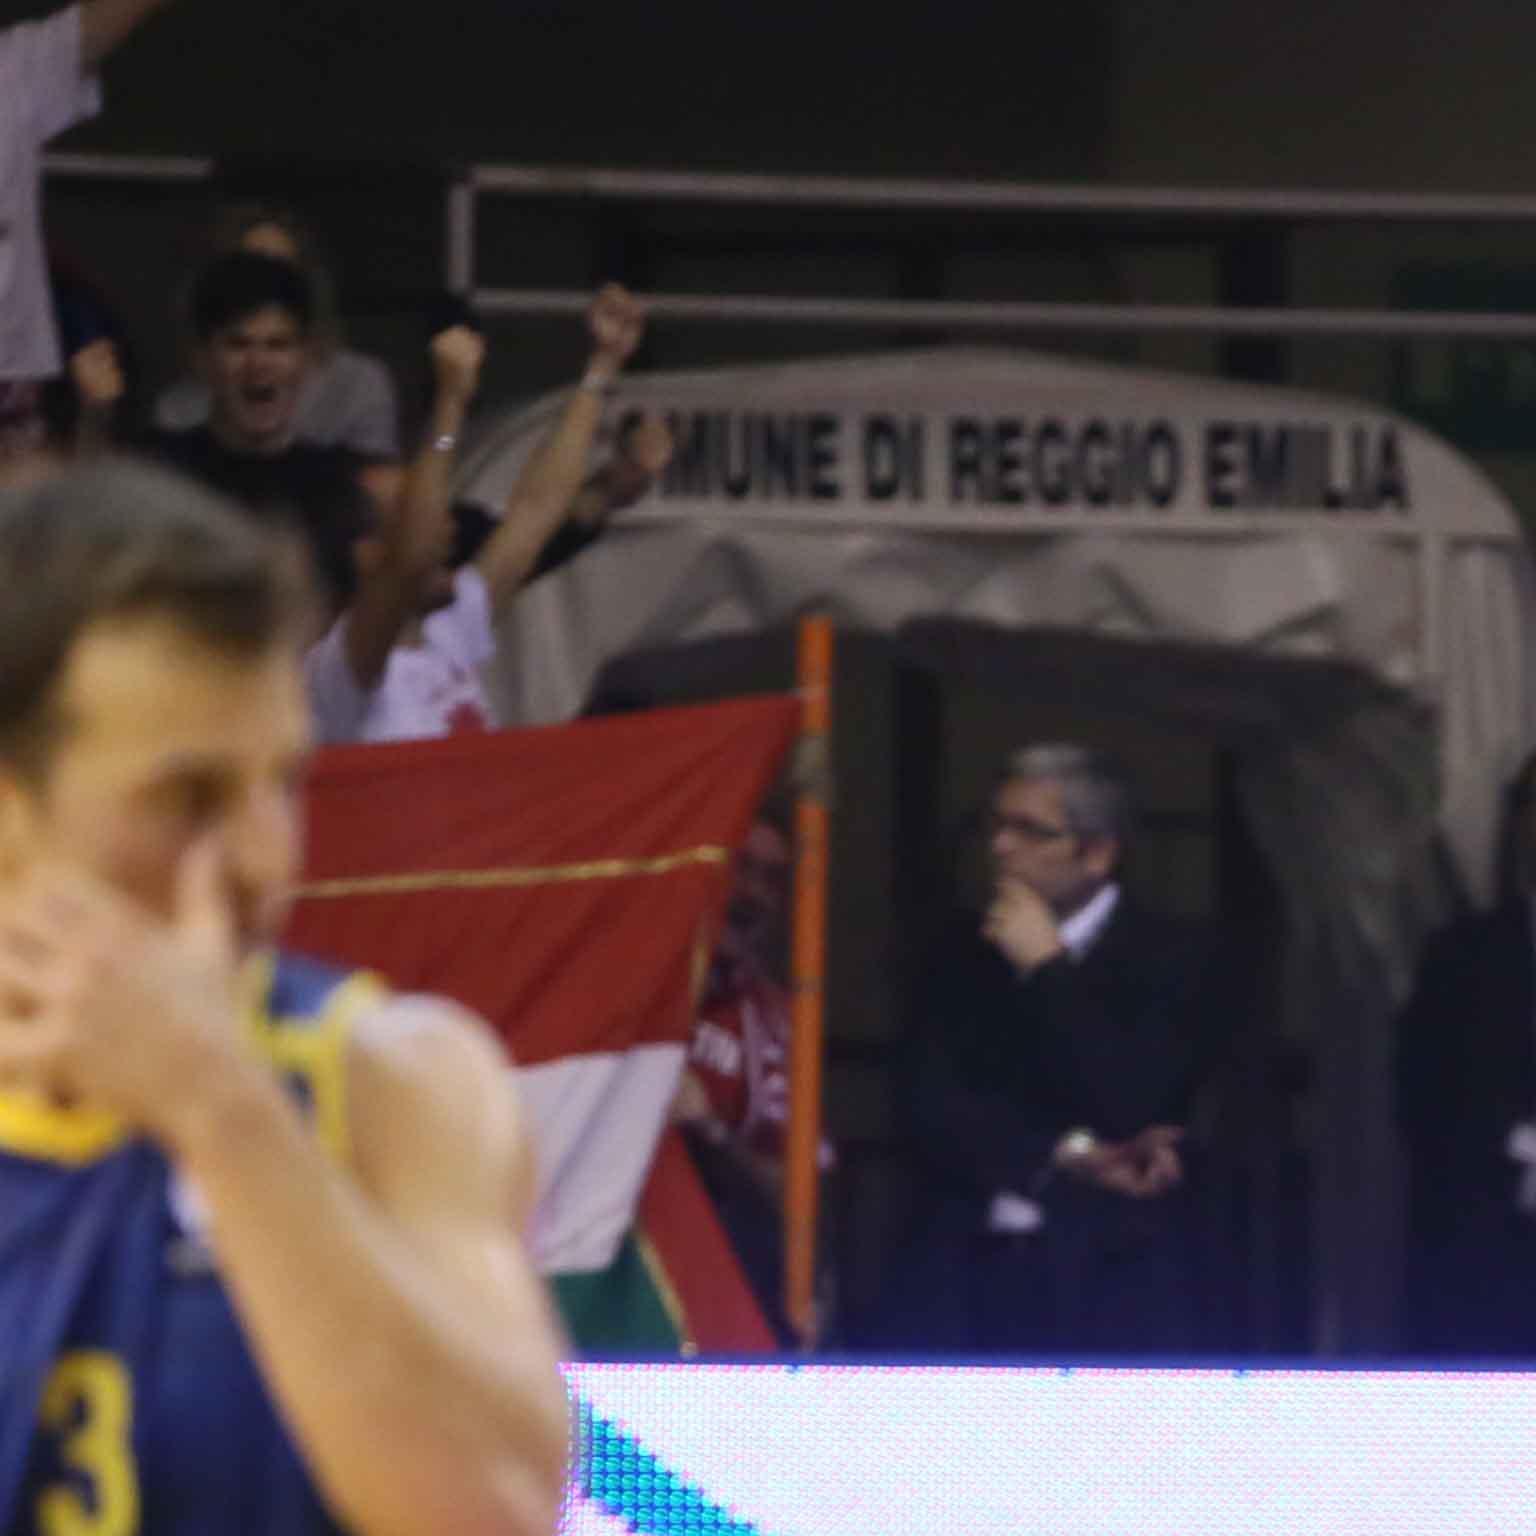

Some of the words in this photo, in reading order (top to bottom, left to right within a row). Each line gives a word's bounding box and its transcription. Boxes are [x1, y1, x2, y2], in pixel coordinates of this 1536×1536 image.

[864, 413, 923, 500] DI
[949, 416, 1180, 506] REGGIO
[1204, 419, 1410, 509] EMILIA
